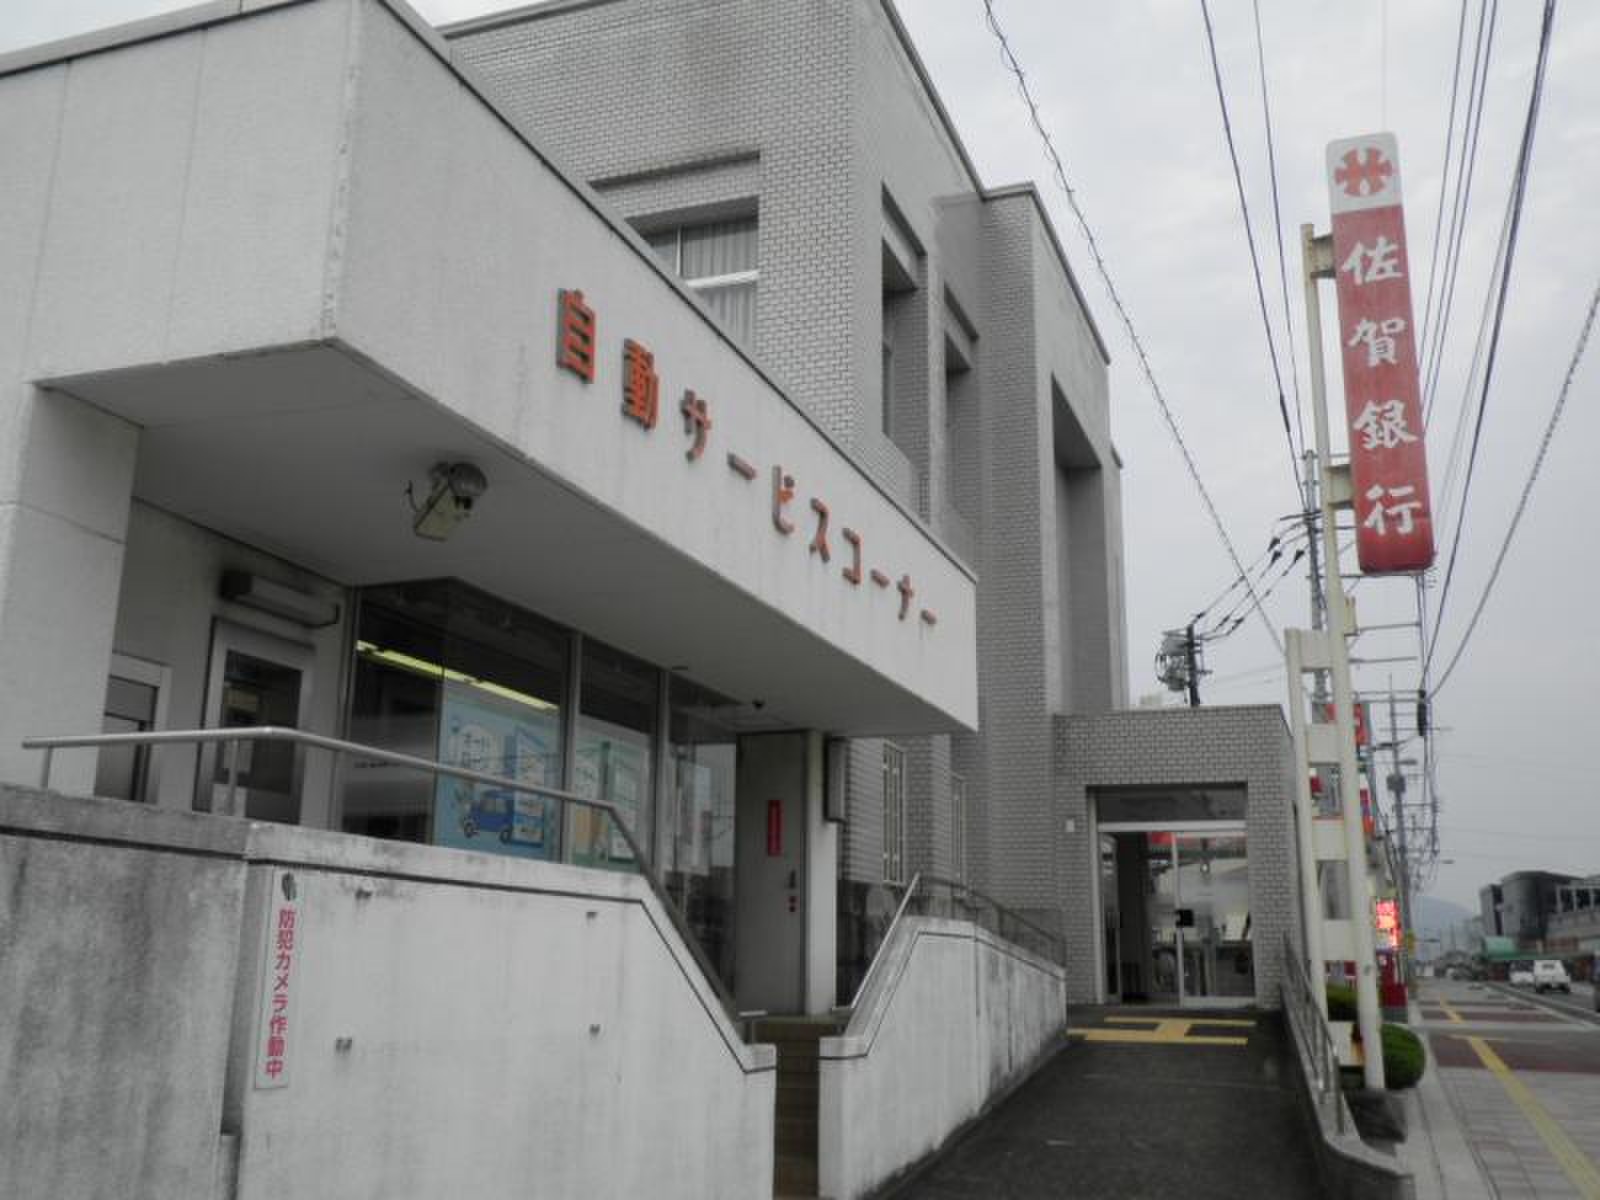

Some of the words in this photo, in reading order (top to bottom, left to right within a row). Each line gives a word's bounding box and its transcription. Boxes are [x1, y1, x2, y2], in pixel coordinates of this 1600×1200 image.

[557, 288, 937, 625] 自動サービスコーナー
[1342, 236, 1422, 536] 佐賀銀行
